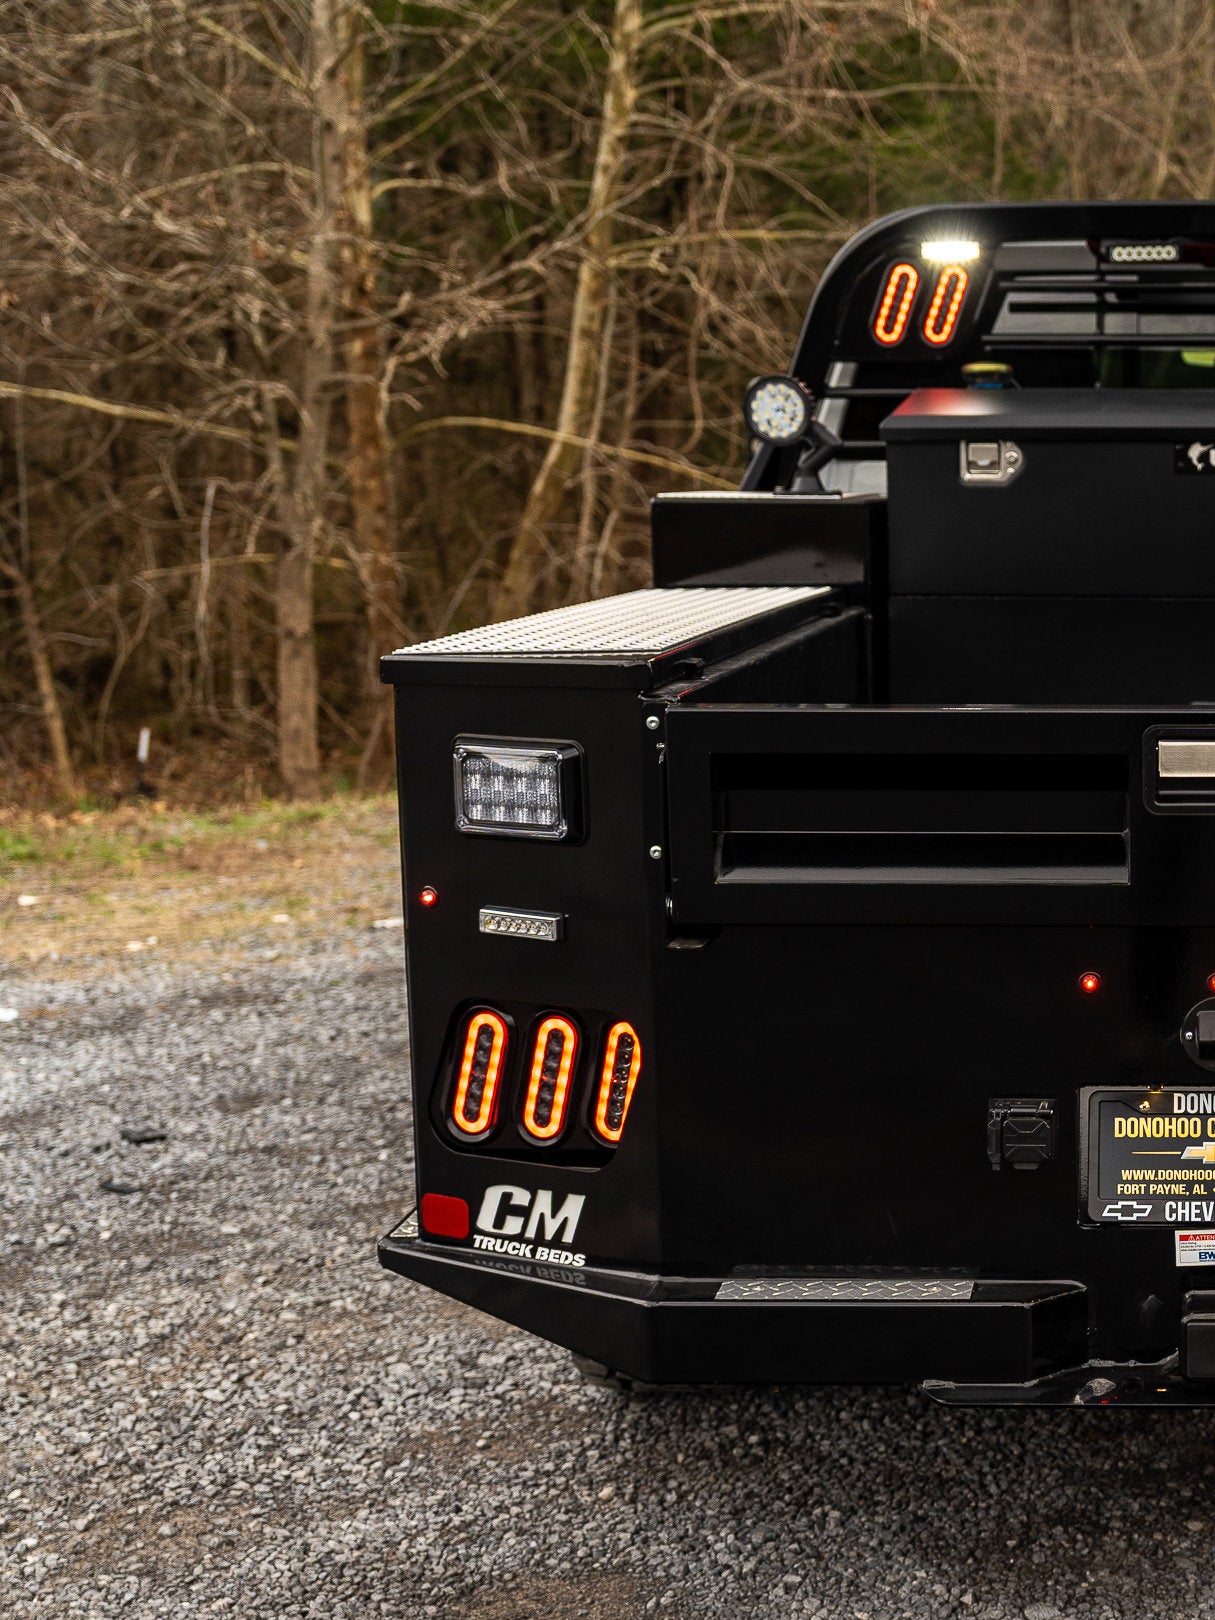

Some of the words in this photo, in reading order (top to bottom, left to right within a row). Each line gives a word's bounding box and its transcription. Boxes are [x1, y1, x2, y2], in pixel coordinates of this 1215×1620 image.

[1114, 1117, 1201, 1139] DONOHOO
[1117, 1184, 1146, 1196] FORT
[1149, 1184, 1190, 1197] PAYNE,
[1192, 1184, 1208, 1196] AL
[476, 1184, 586, 1244] CM
[473, 1234, 533, 1259] TRUCK
[534, 1247, 587, 1267] BEDS
